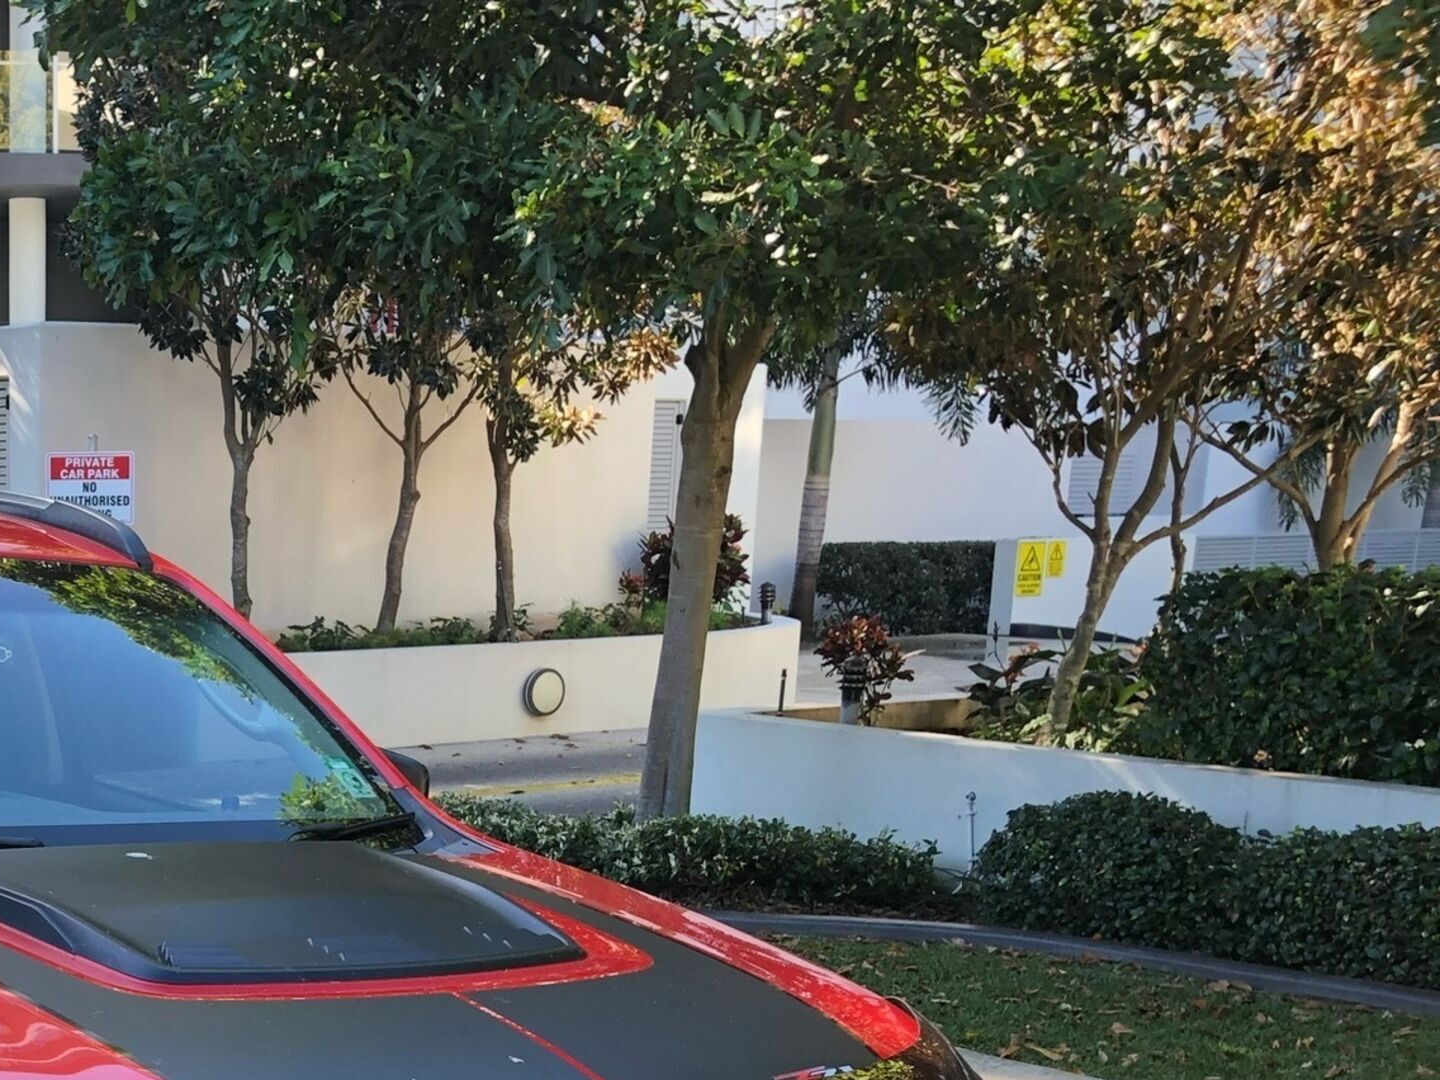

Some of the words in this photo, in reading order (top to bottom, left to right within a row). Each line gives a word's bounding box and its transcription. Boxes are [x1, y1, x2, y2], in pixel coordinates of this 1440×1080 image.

[65, 456, 115, 468] PRIVATE
[60, 468, 85, 479] CAR
[87, 468, 120, 479] PARK
[82, 481, 97, 493] NO
